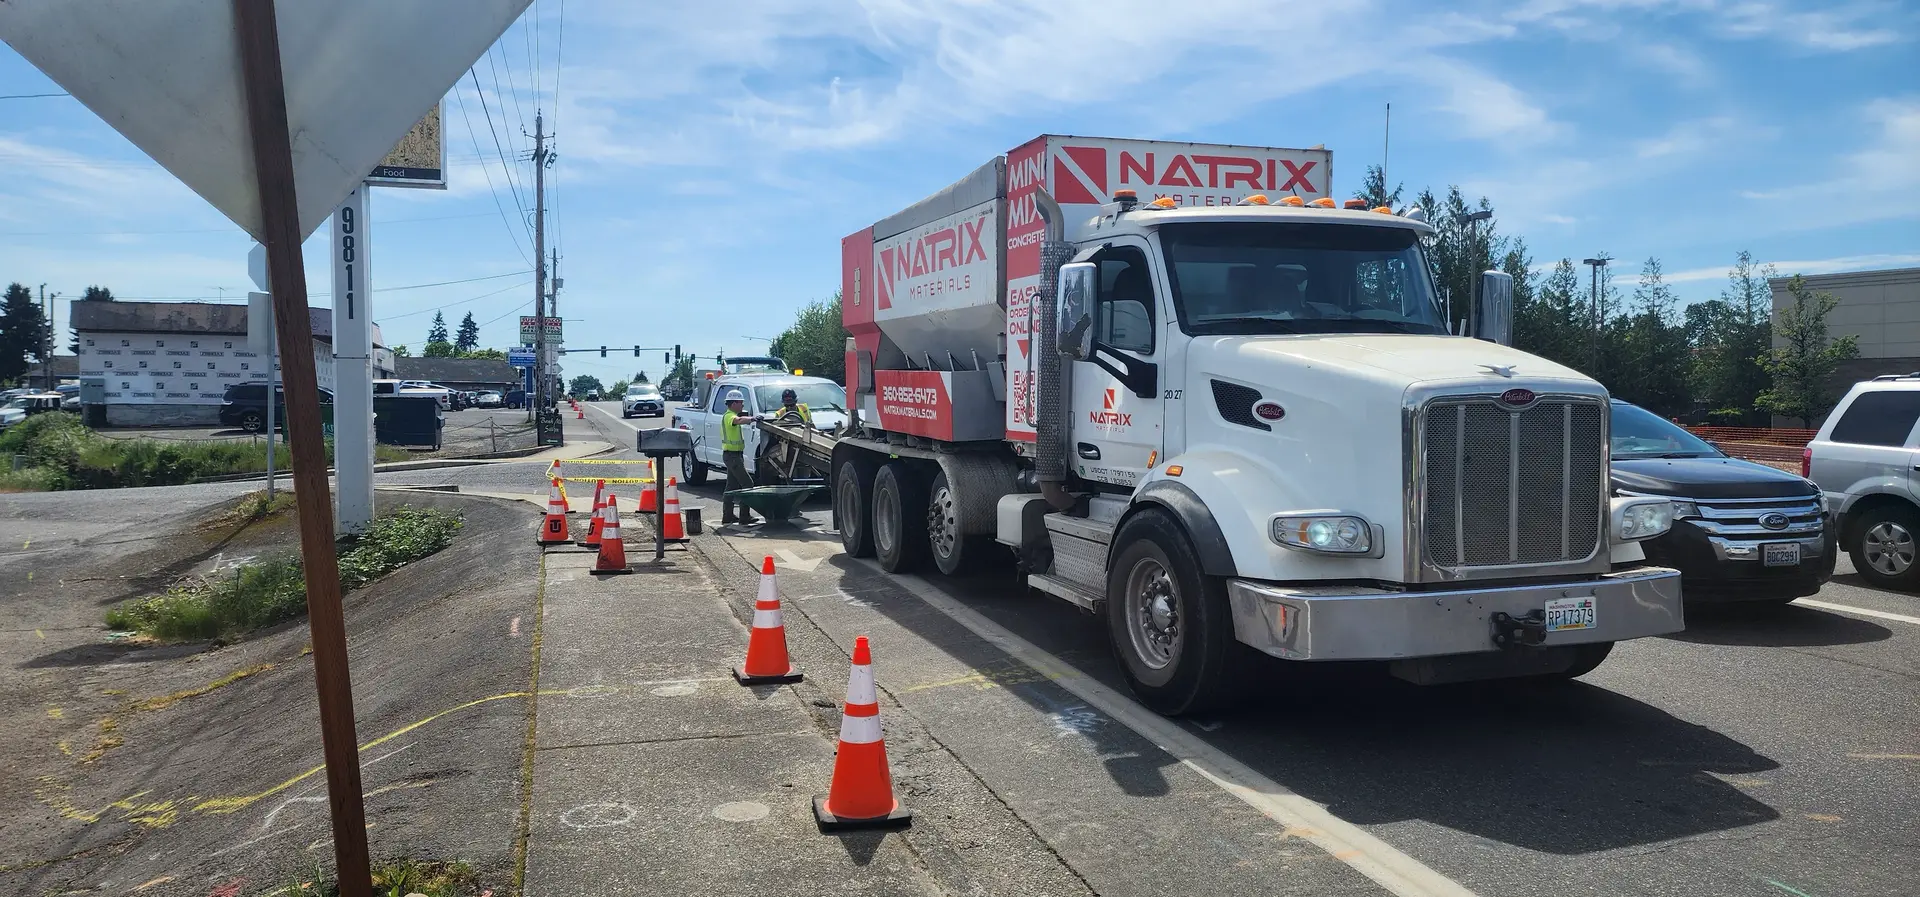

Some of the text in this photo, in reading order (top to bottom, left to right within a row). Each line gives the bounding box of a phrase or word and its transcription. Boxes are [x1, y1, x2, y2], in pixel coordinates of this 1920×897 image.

[383, 168, 405, 177] Food
[1008, 151, 1046, 193] MINI
[1119, 151, 1318, 193] NATRIX
[1154, 193, 1241, 207] MATERI
[1008, 192, 1044, 230] MIX
[897, 217, 988, 281] NATRIX
[1008, 229, 1046, 250] CONCRETE
[341, 190, 355, 320] 9811
[909, 274, 971, 299] MATERIALS
[1010, 285, 1041, 306] EASY
[1010, 319, 1041, 335] ONLNE
[882, 385, 937, 405] 360-852-6473
[1164, 389, 1183, 400] 20 27
[883, 404, 938, 420] NATRIXMATERIALS.COM
[1090, 411, 1132, 427] NATRIX
[1769, 516, 1785, 525] Ford
[1548, 608, 1594, 627] RP17379
